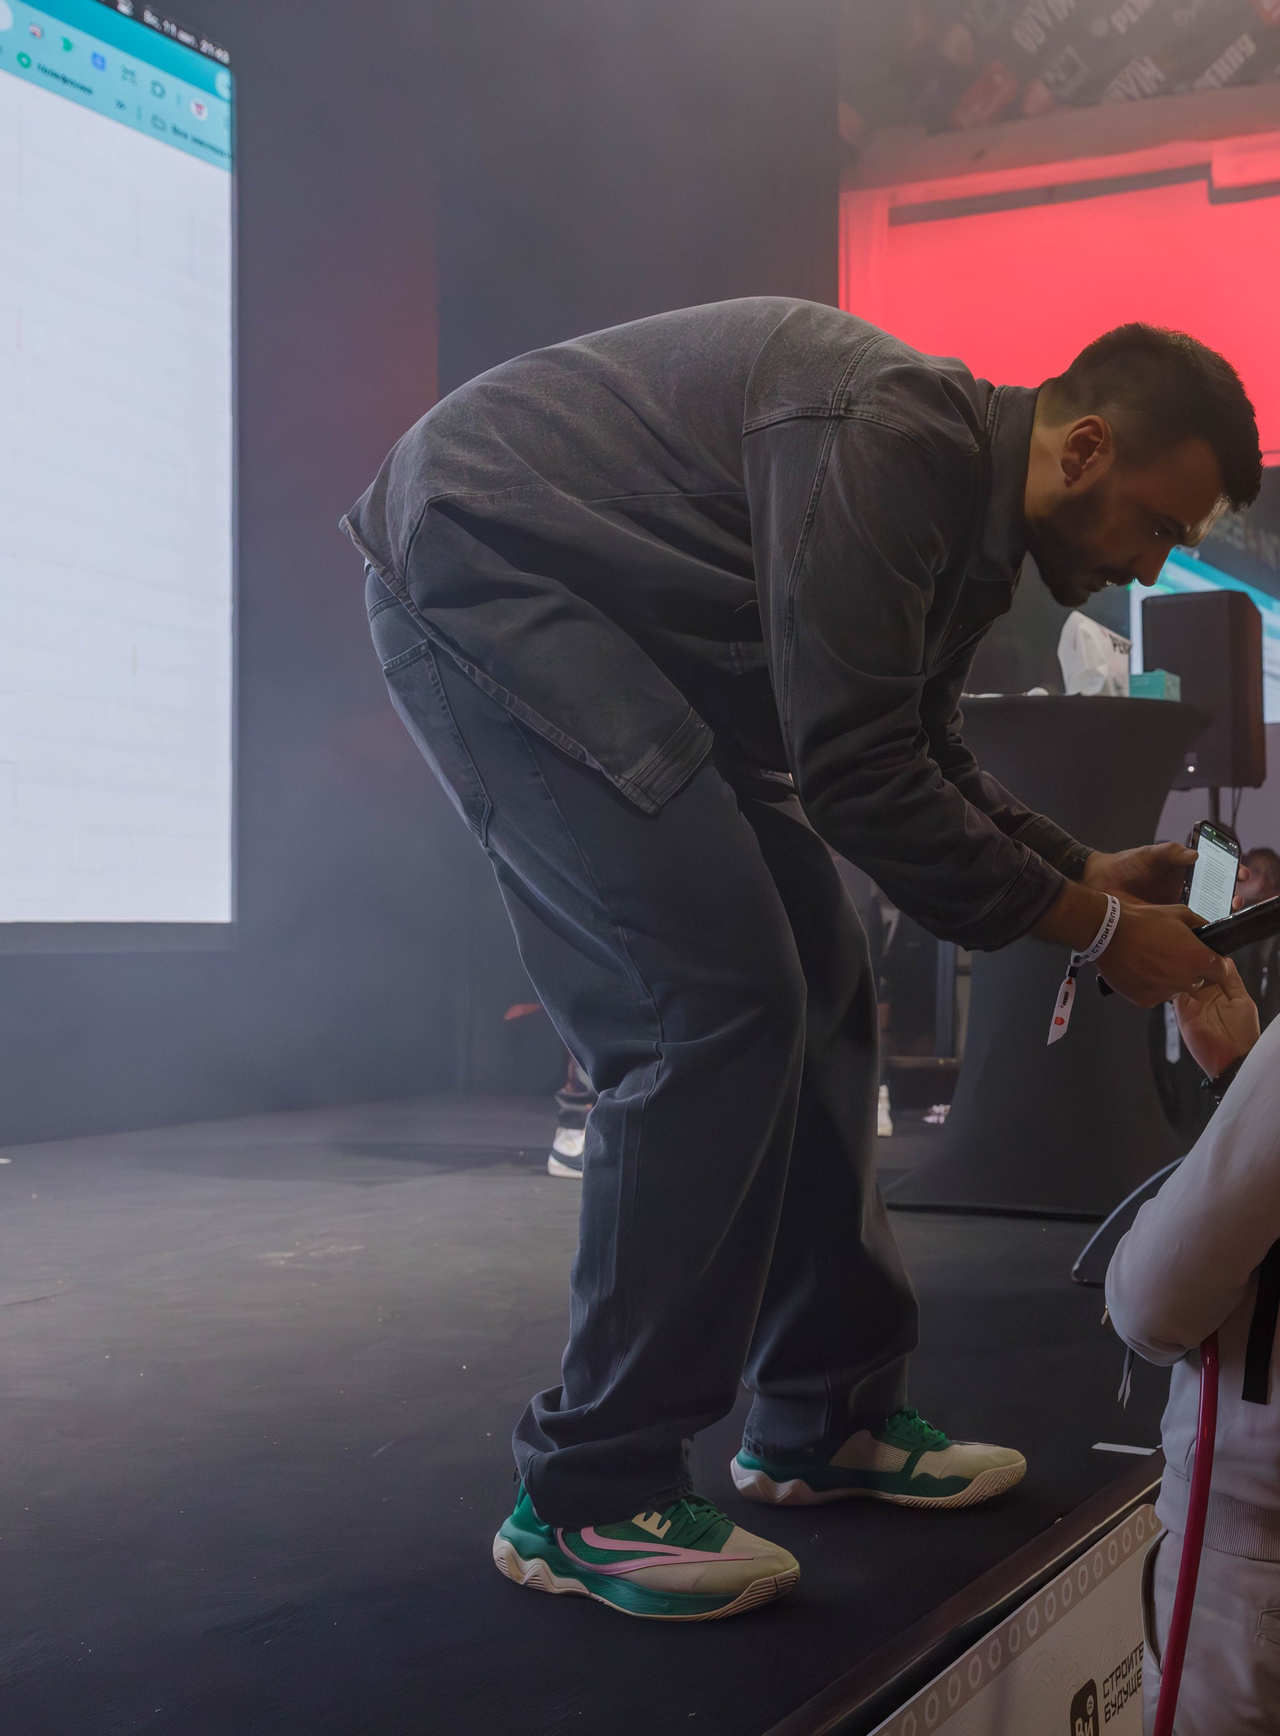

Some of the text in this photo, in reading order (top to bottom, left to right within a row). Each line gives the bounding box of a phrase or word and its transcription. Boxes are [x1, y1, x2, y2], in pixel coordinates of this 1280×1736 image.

[1091, 906, 1117, 954] СТРОИТЕЛИ
[1103, 1640, 1144, 1700] СТРОИТЕ
[1104, 1667, 1143, 1724] БУДУЩЕ
